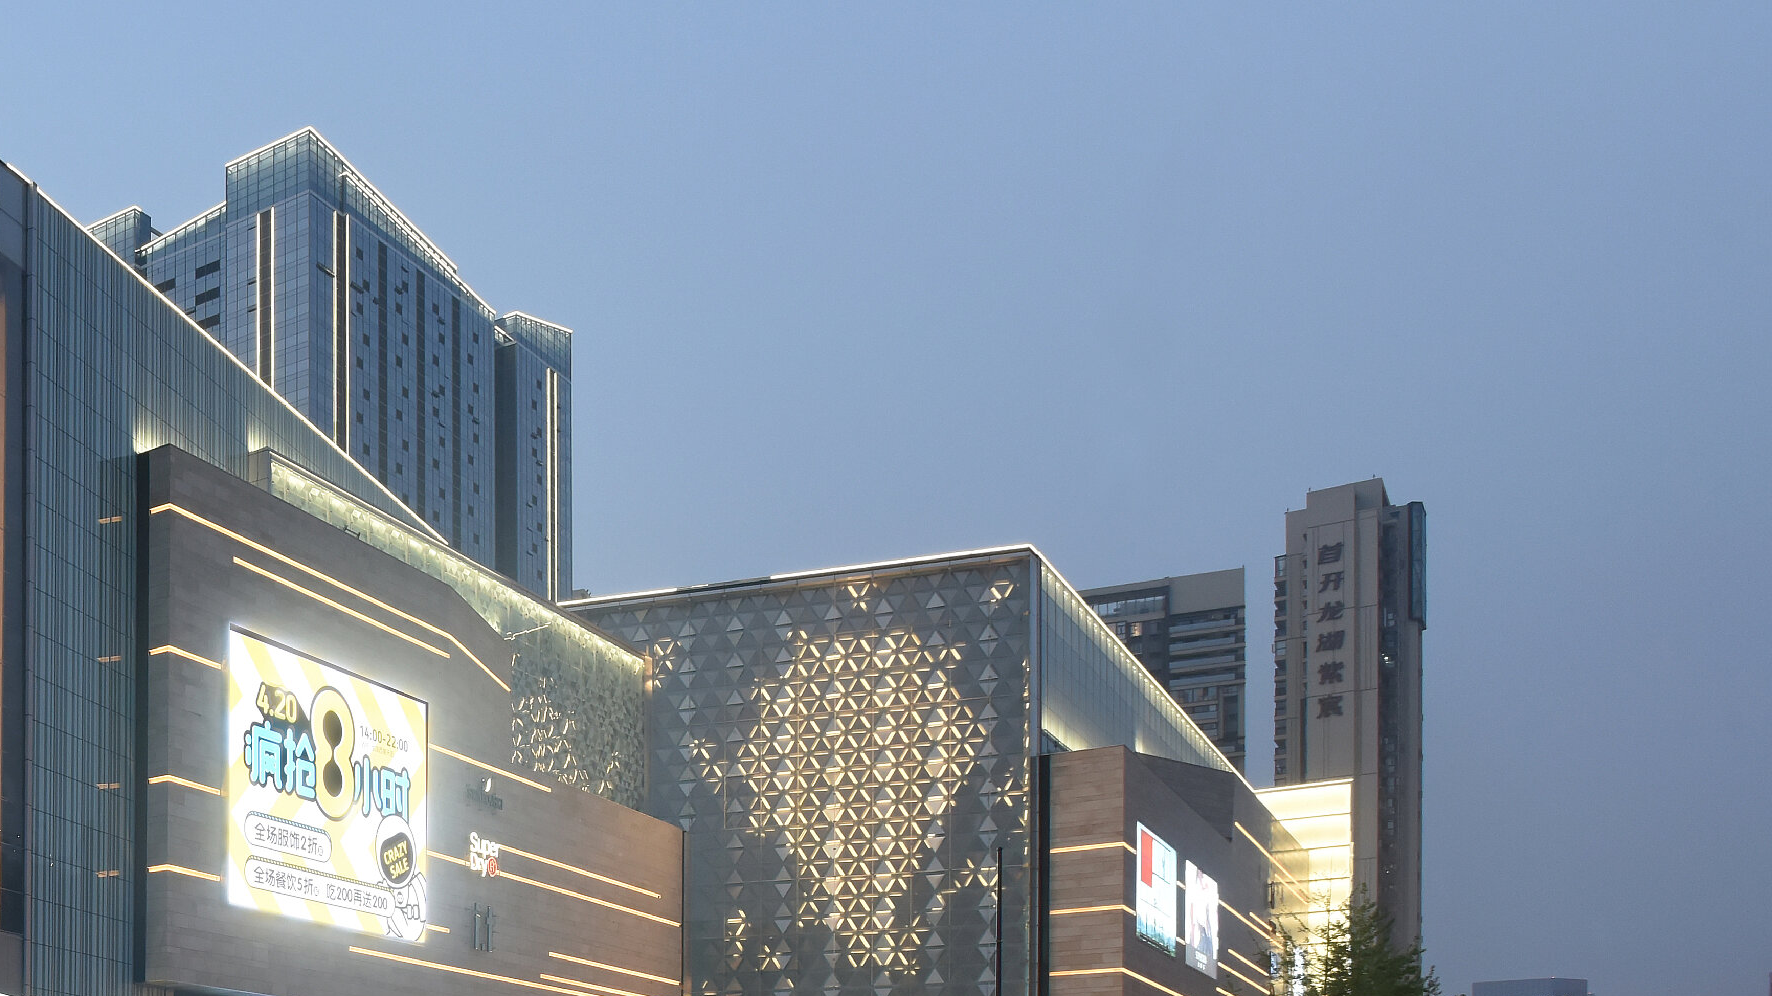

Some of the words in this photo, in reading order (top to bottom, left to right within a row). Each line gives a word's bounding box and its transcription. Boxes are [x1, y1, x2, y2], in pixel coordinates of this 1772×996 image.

[256, 683, 298, 724] 4.20
[383, 839, 409, 866] CRAZY
[469, 831, 500, 858] Super
[389, 860, 410, 880] SALE
